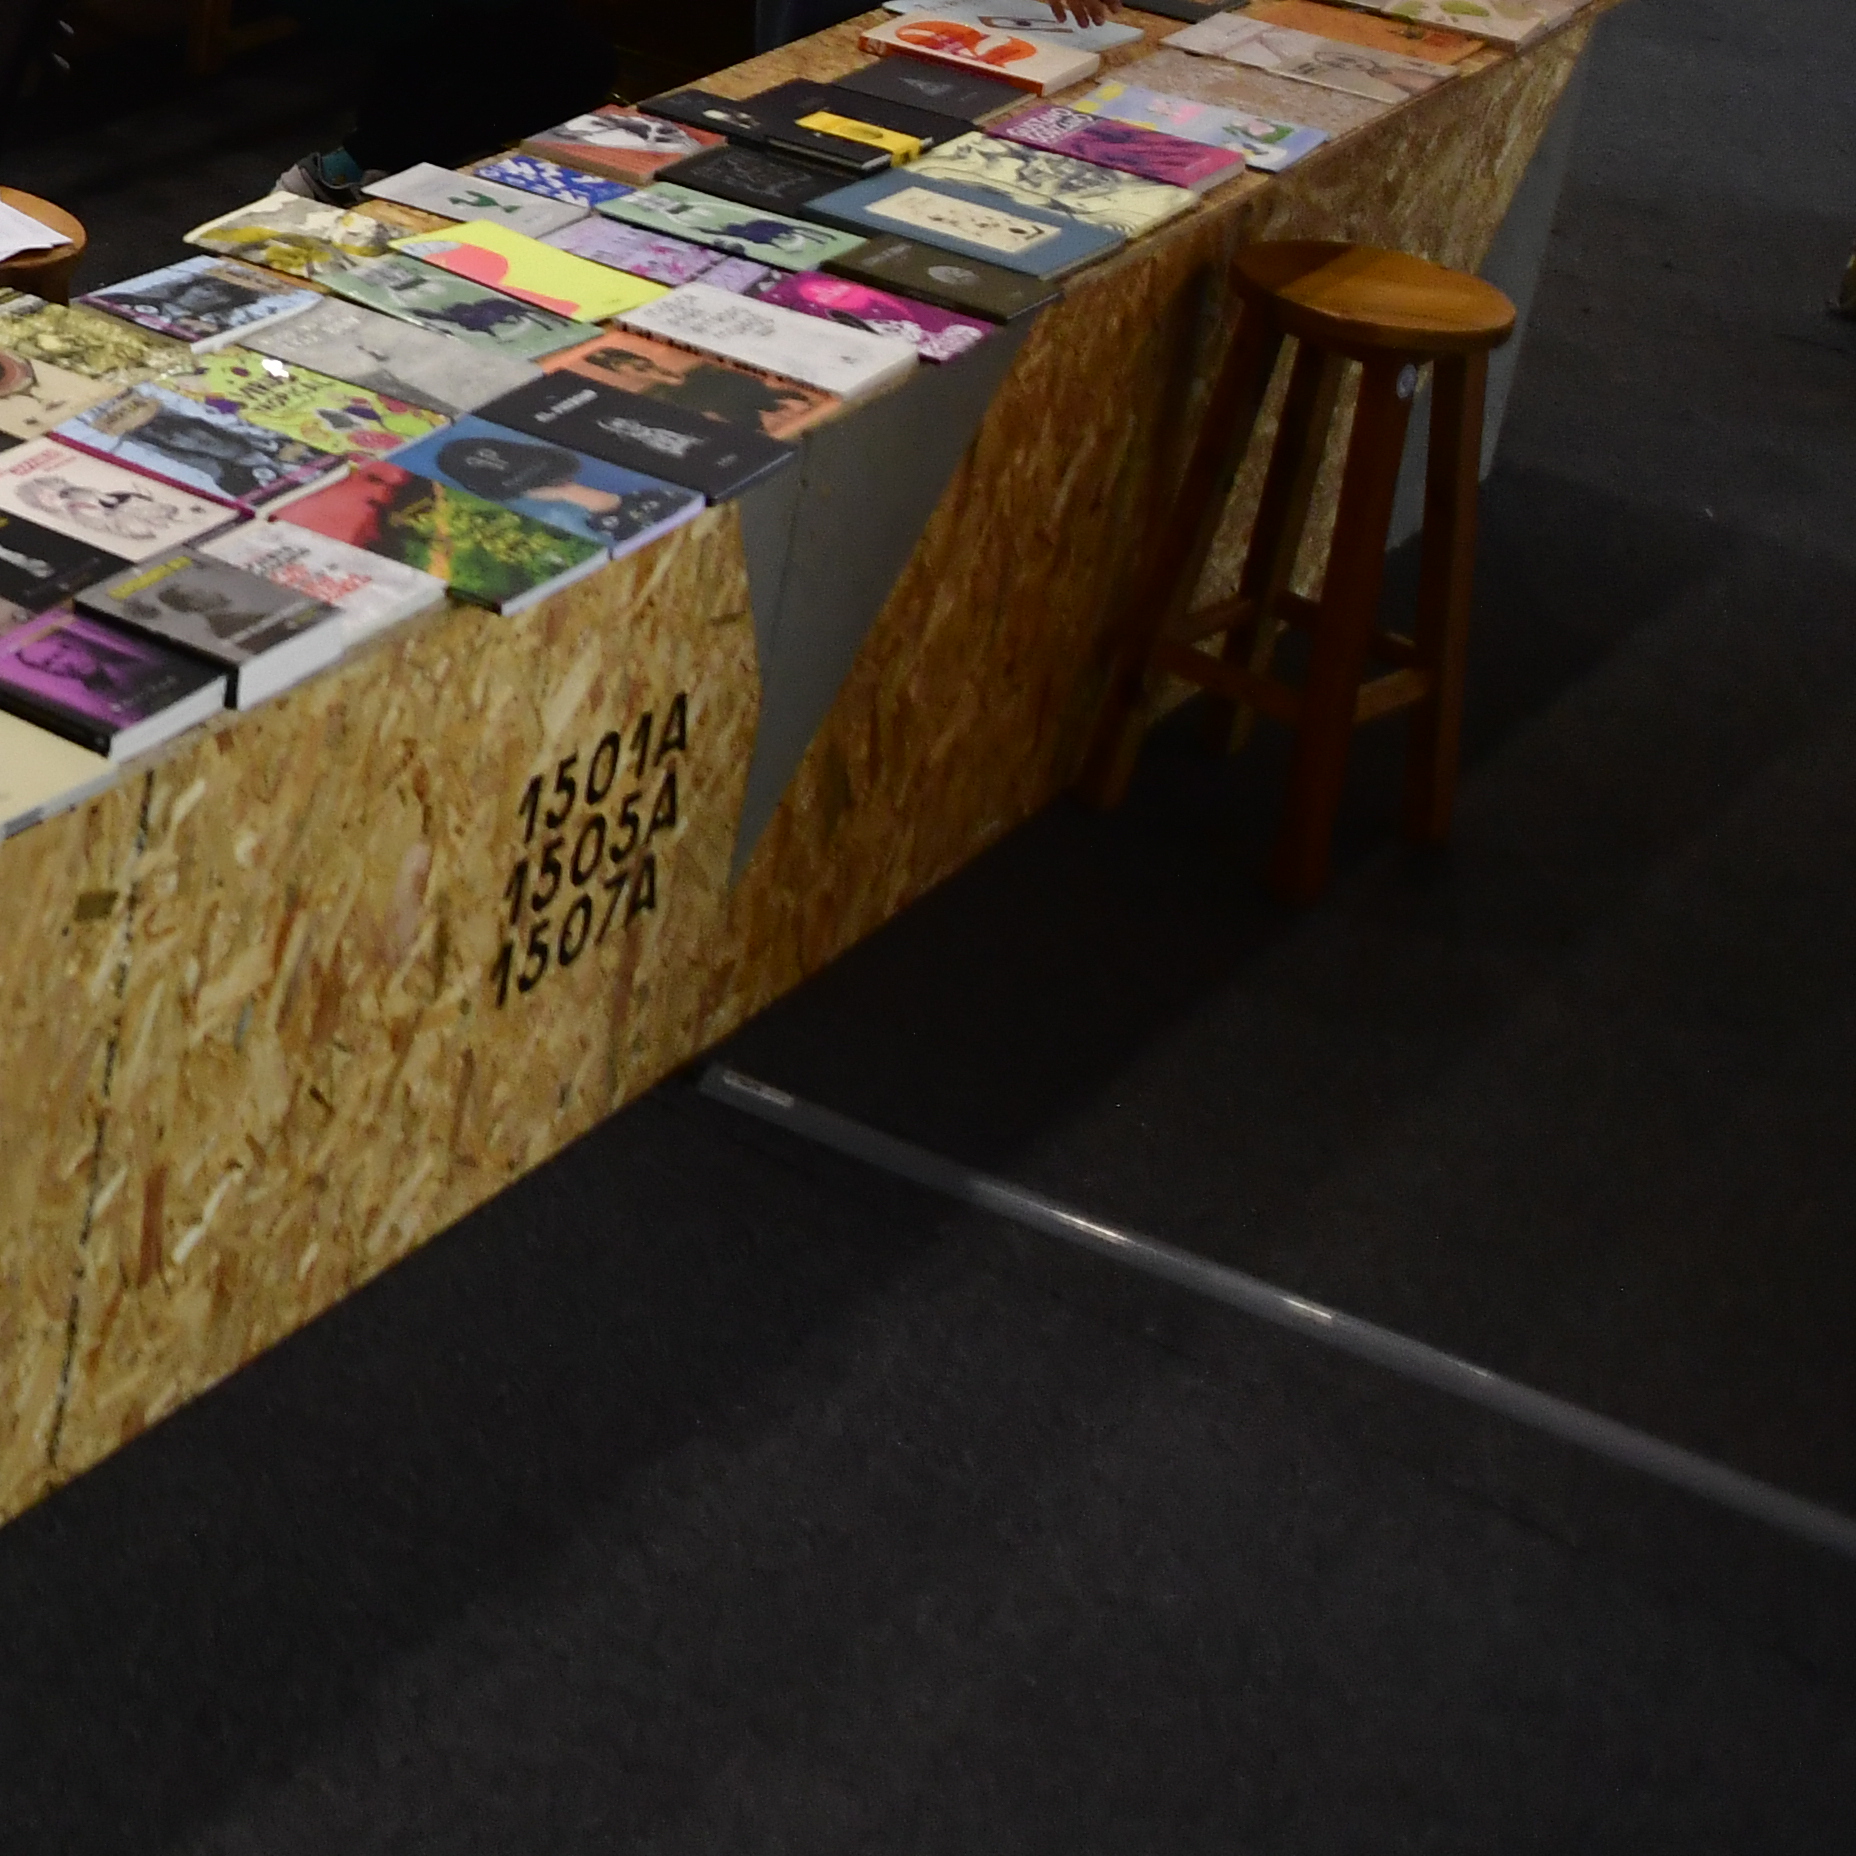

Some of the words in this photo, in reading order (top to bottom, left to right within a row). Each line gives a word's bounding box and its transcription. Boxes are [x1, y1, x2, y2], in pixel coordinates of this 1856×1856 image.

[519, 690, 688, 844] 1501A
[505, 769, 678, 927] 1505A
[490, 852, 658, 1011] 1507A
